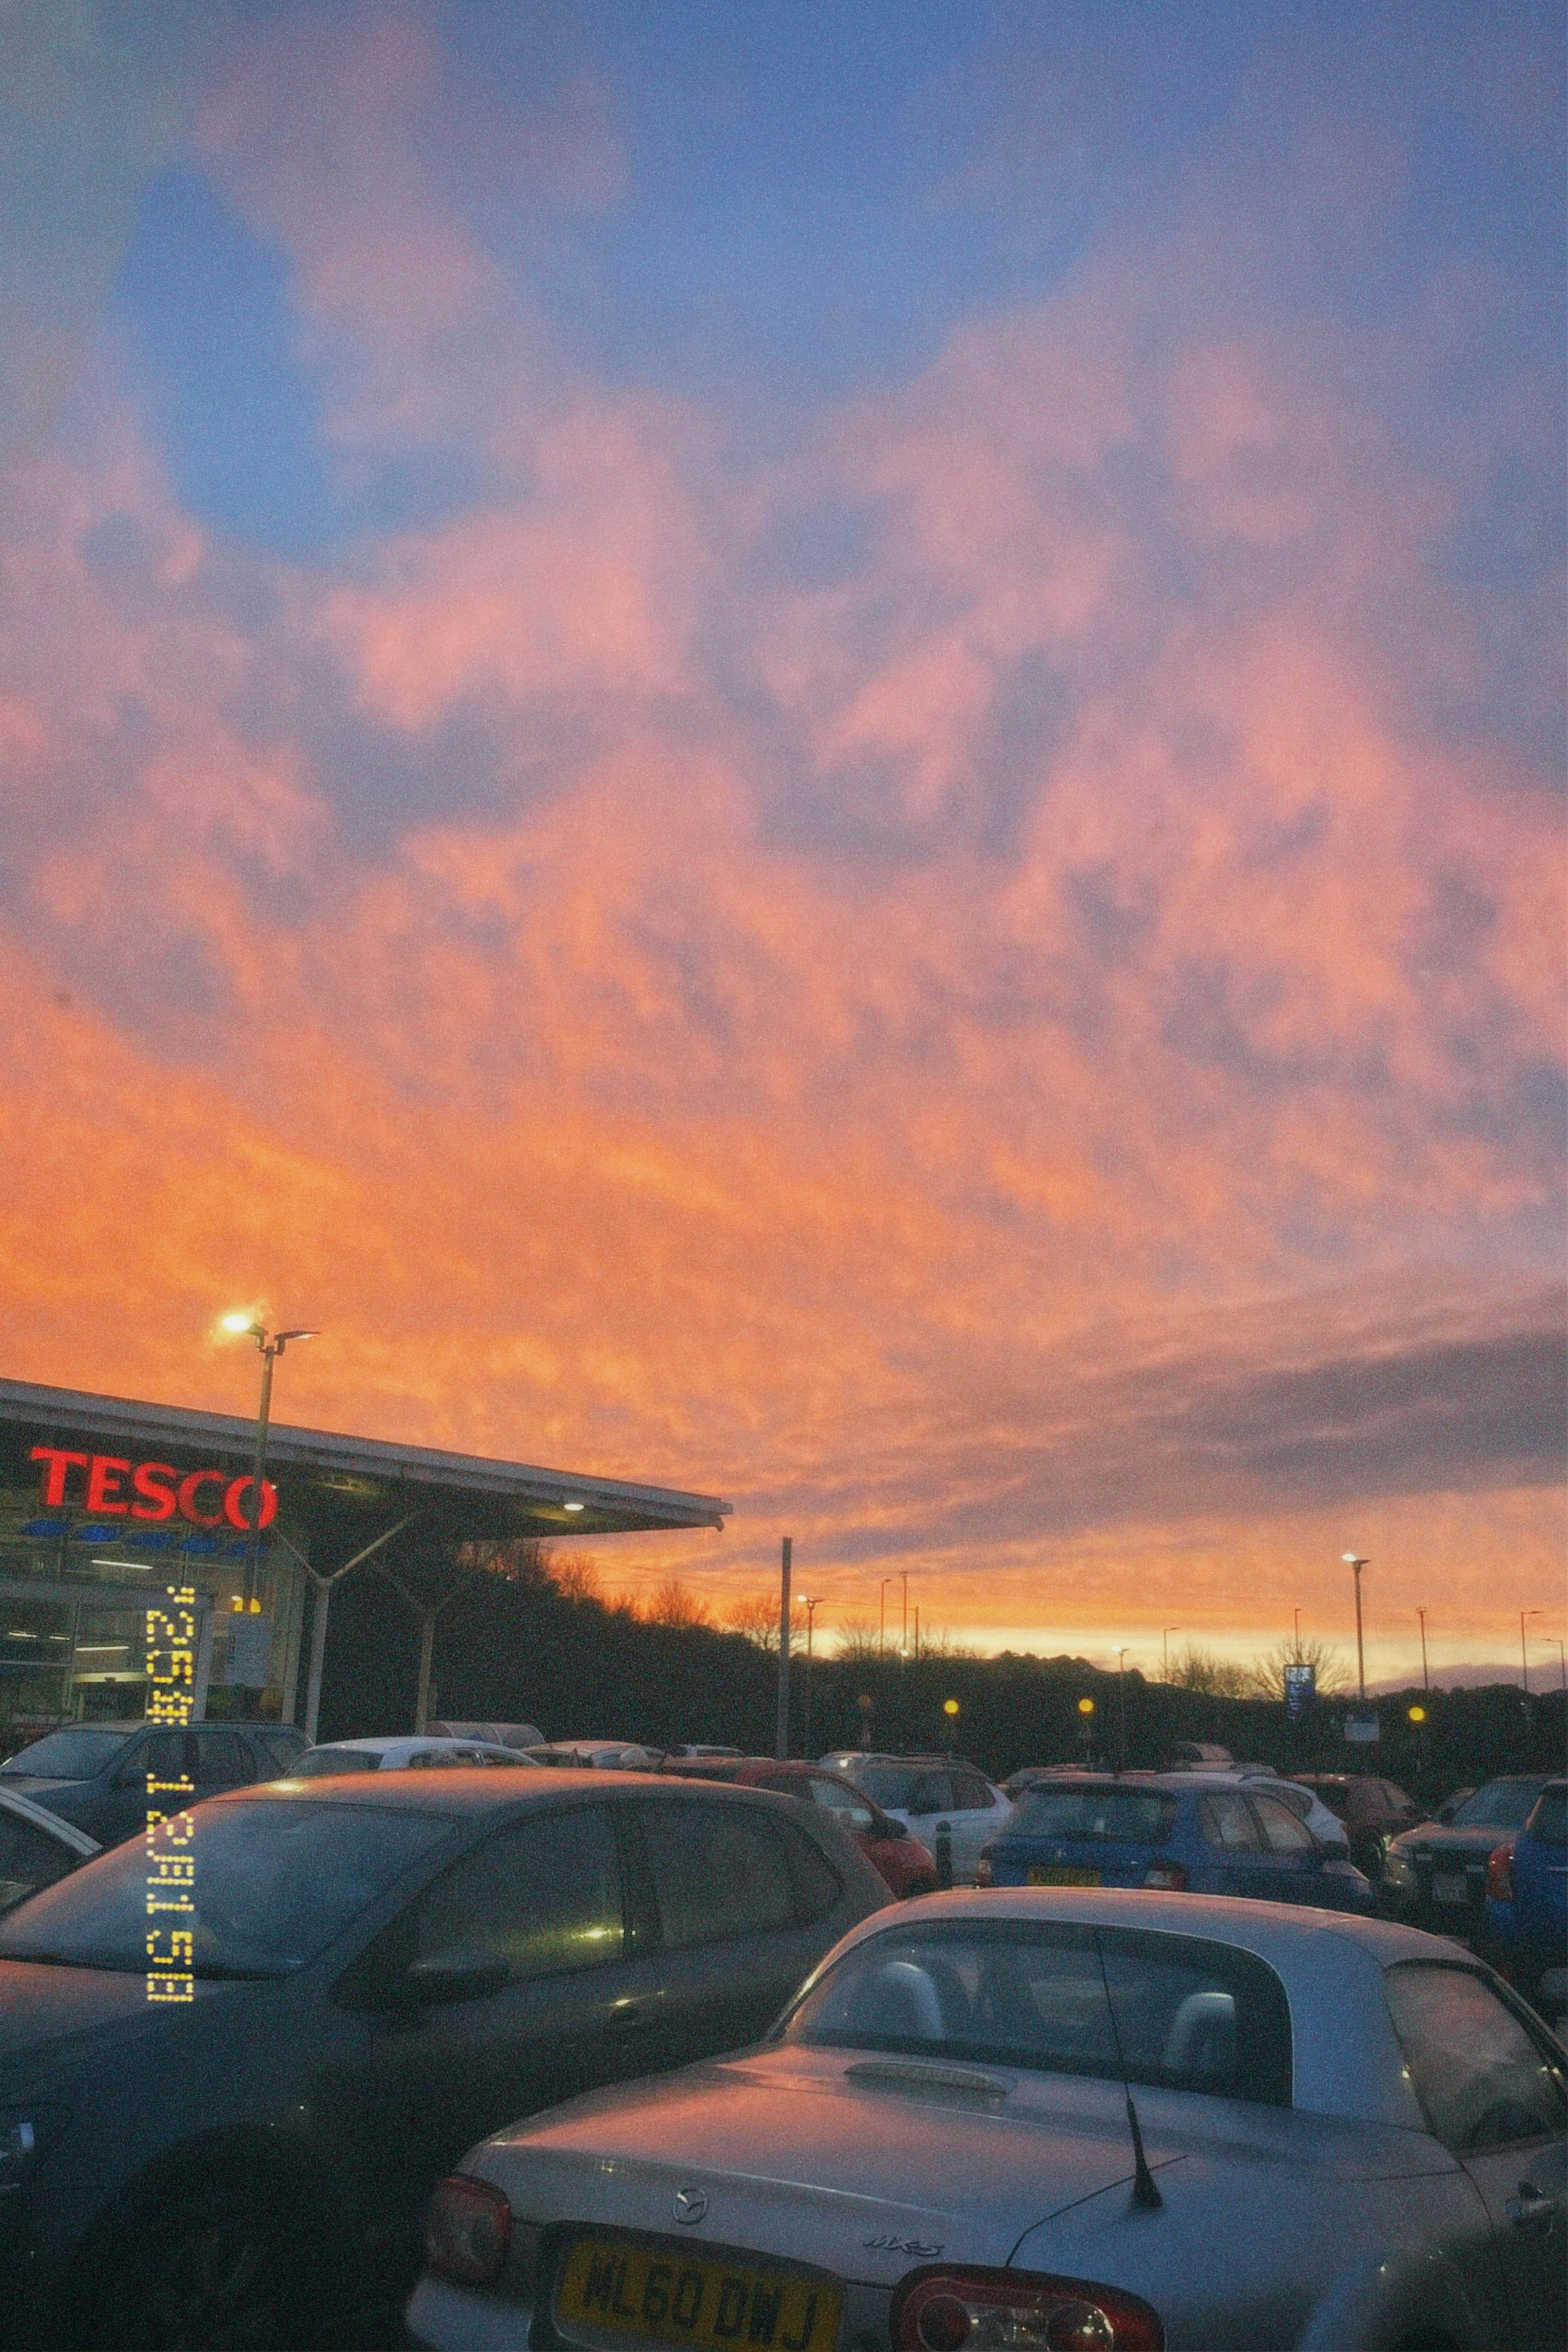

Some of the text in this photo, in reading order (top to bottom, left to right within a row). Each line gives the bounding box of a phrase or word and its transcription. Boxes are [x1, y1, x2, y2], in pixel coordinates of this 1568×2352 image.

[30, 1447, 278, 1530] TESCO
[583, 2252, 819, 2351] ML60 DWJ
